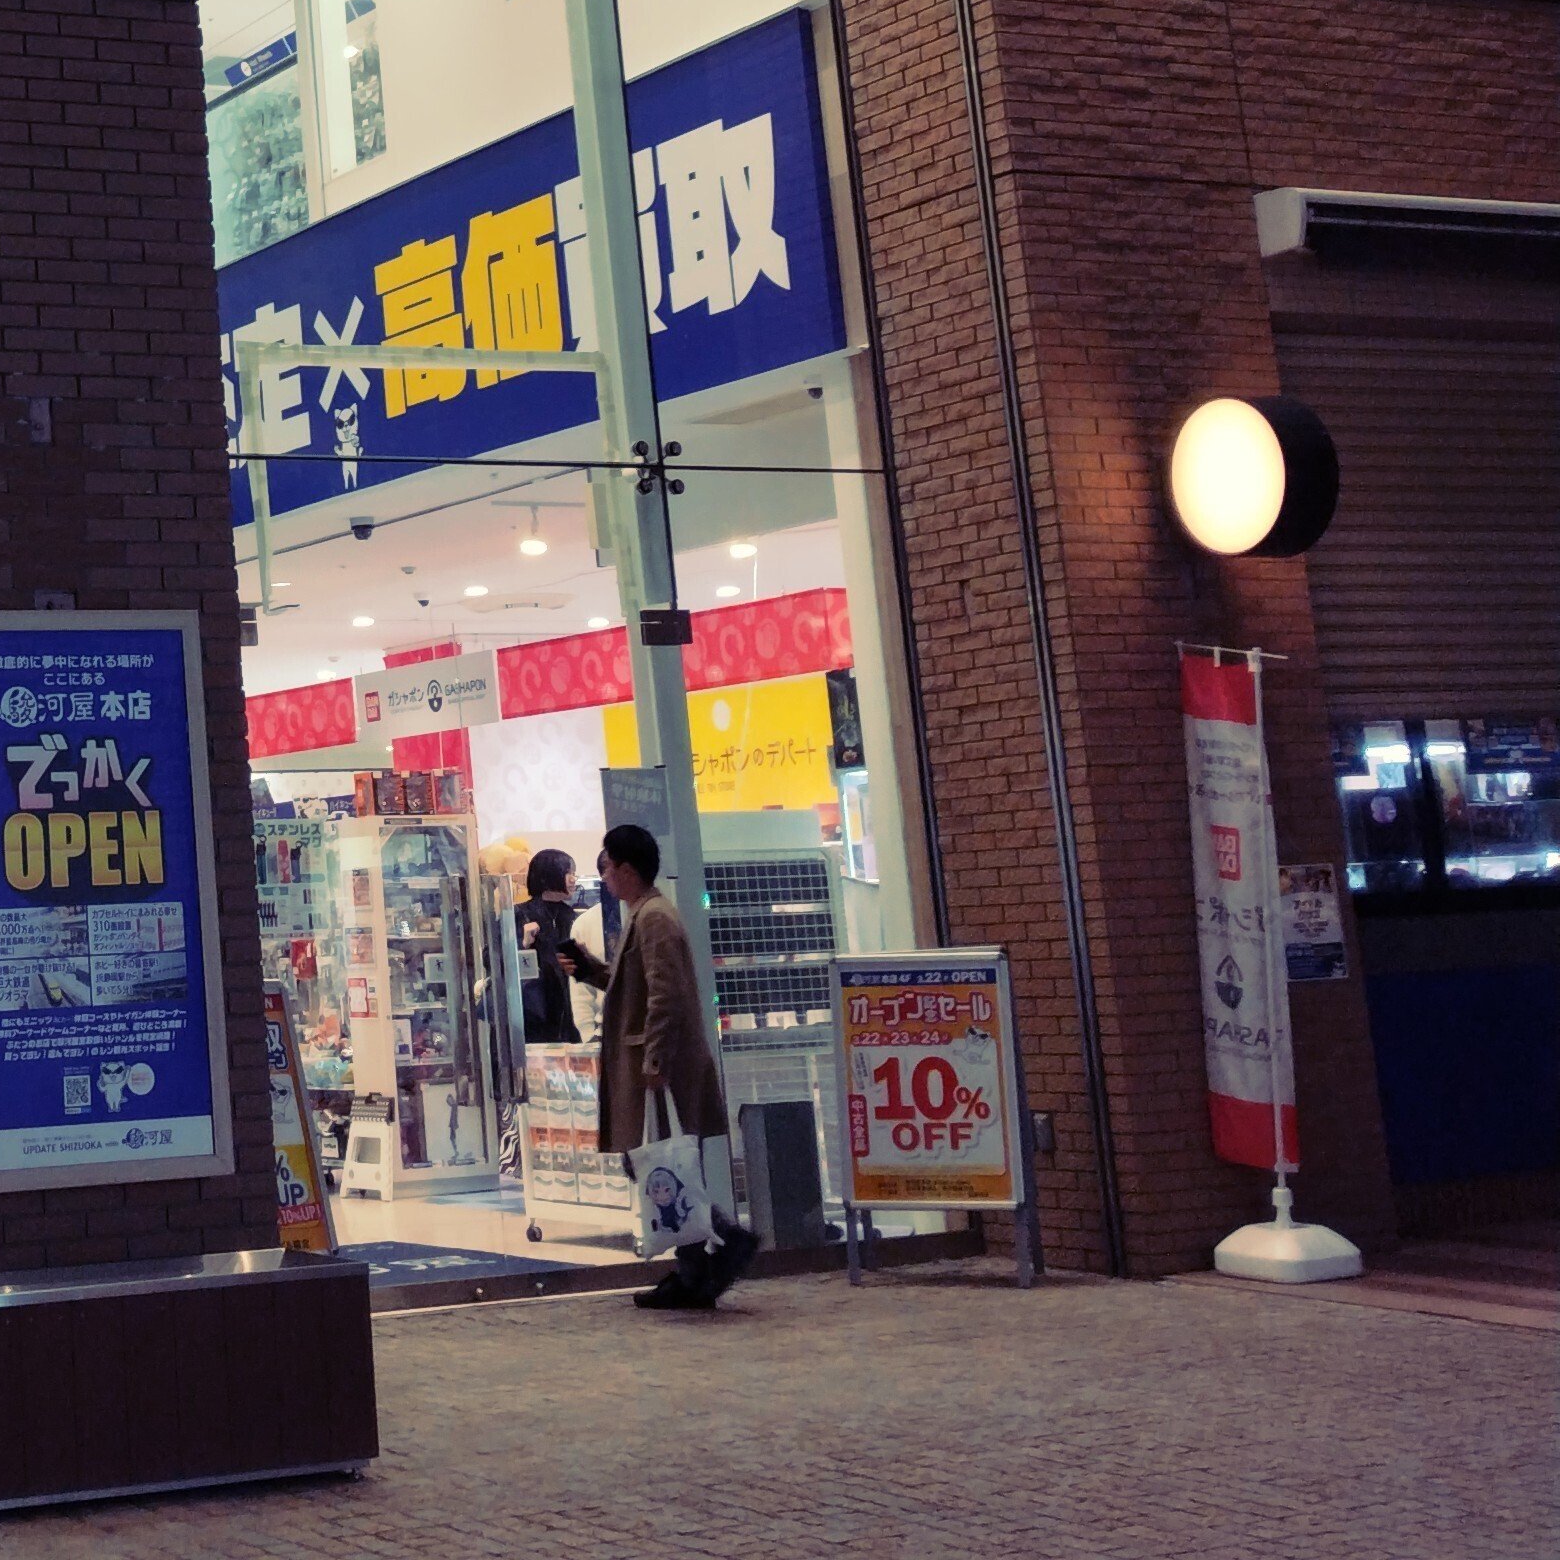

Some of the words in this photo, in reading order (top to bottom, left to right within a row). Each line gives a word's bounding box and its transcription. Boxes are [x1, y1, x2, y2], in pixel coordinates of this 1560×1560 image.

[43, 672, 105, 686] ここにある
[100, 690, 152, 721] 本店
[6, 732, 153, 809] でっかく
[267, 823, 321, 836] ステンレス
[3, 809, 164, 891] OPEN
[951, 971, 987, 982] OPEN
[873, 1056, 991, 1121] 10%
[23, 1142, 56, 1155] UPDATE
[59, 1139, 103, 1153] SHIZUOKA
[892, 1122, 973, 1151] OFF
